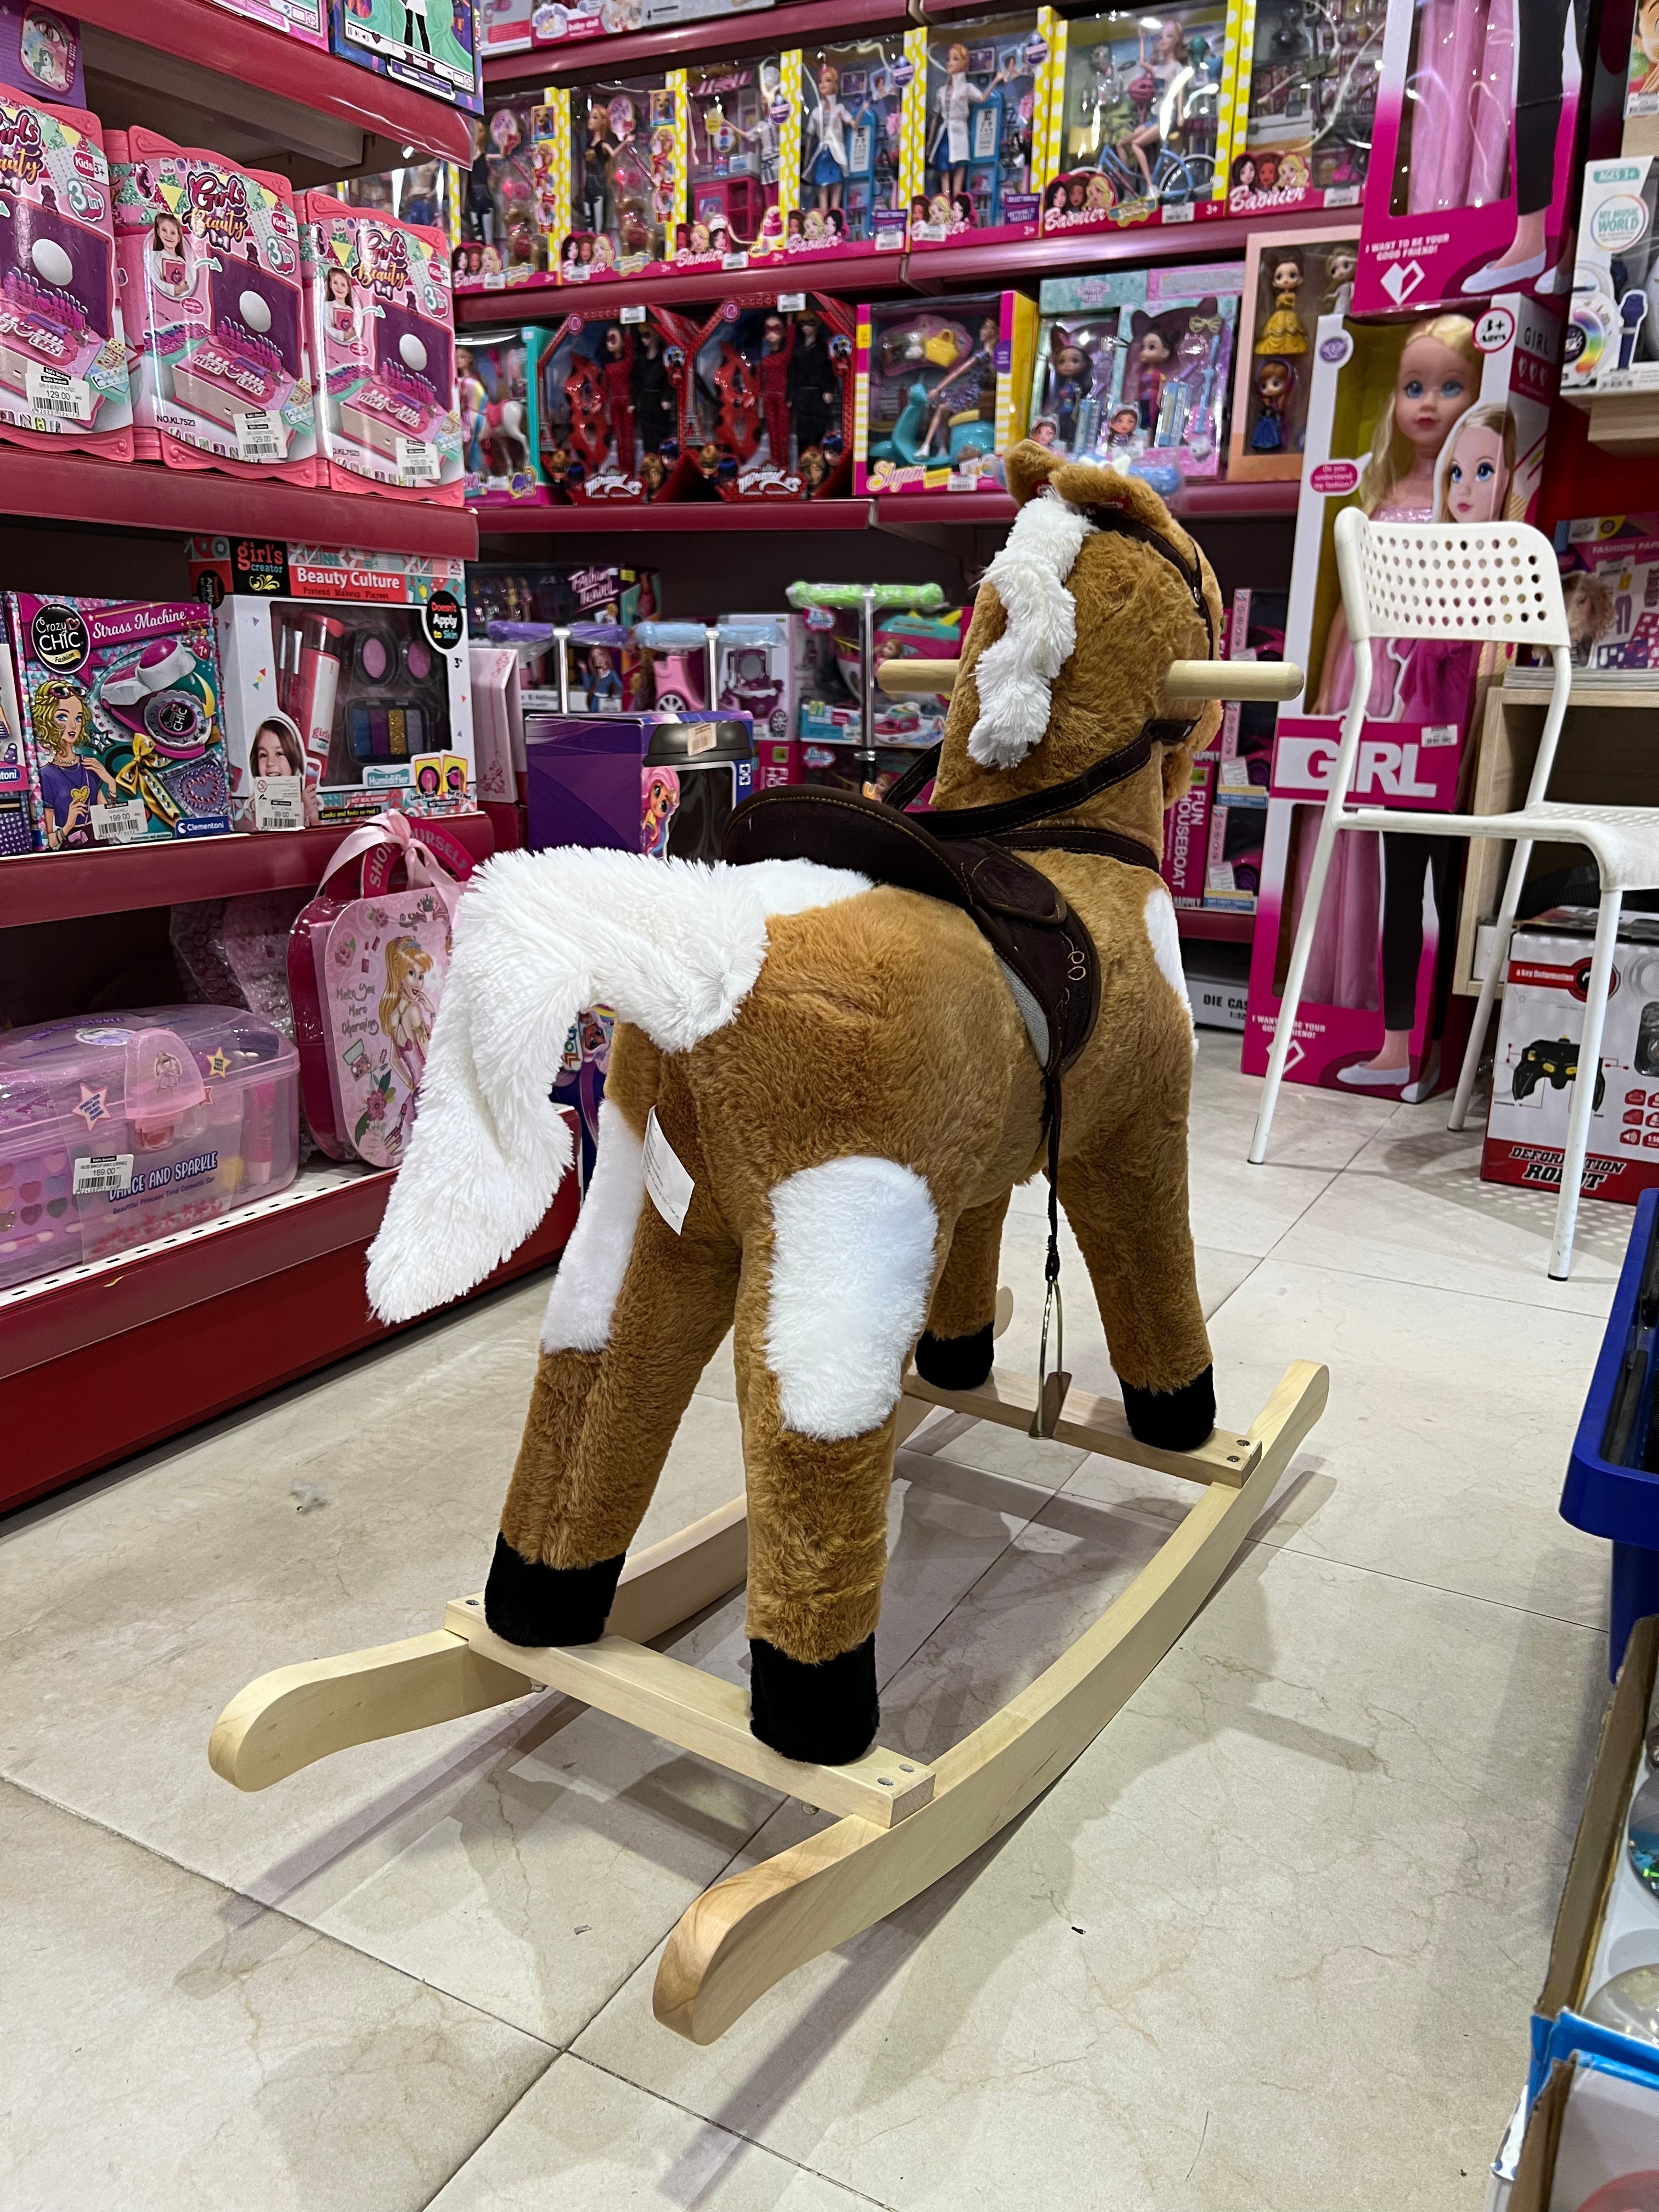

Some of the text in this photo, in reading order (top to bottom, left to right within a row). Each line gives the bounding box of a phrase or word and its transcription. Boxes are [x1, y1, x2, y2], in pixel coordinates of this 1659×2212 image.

[75, 156, 105, 177] Kids 3+
[190, 176, 245, 211] Girls
[189, 208, 246, 241] Beauty
[1524, 326, 1548, 355] GIRL
[238, 540, 284, 571] girl's
[251, 563, 284, 574] creator
[297, 567, 400, 590] Beauty Culture
[36, 617, 67, 636] Crazy
[93, 608, 187, 640] Strass Machine
[433, 613, 458, 629] Apply
[40, 632, 81, 651] CHIC
[173, 707, 188, 731] CHIC
[369, 774, 409, 786] Humidifier
[1189, 790, 1206, 826] FUN
[187, 821, 224, 831] Clementoni
[349, 1004, 368, 1017] More
[1203, 994, 1223, 1007] DIE
[1305, 1022, 1326, 1033] YOUR
[93, 1167, 115, 1176] 169.00
[149, 1167, 171, 1189] AND
[175, 1151, 217, 1180] SPARKLE
[1510, 1146, 1626, 1175] DEFORTION
[1523, 1162, 1607, 1190] ROT
